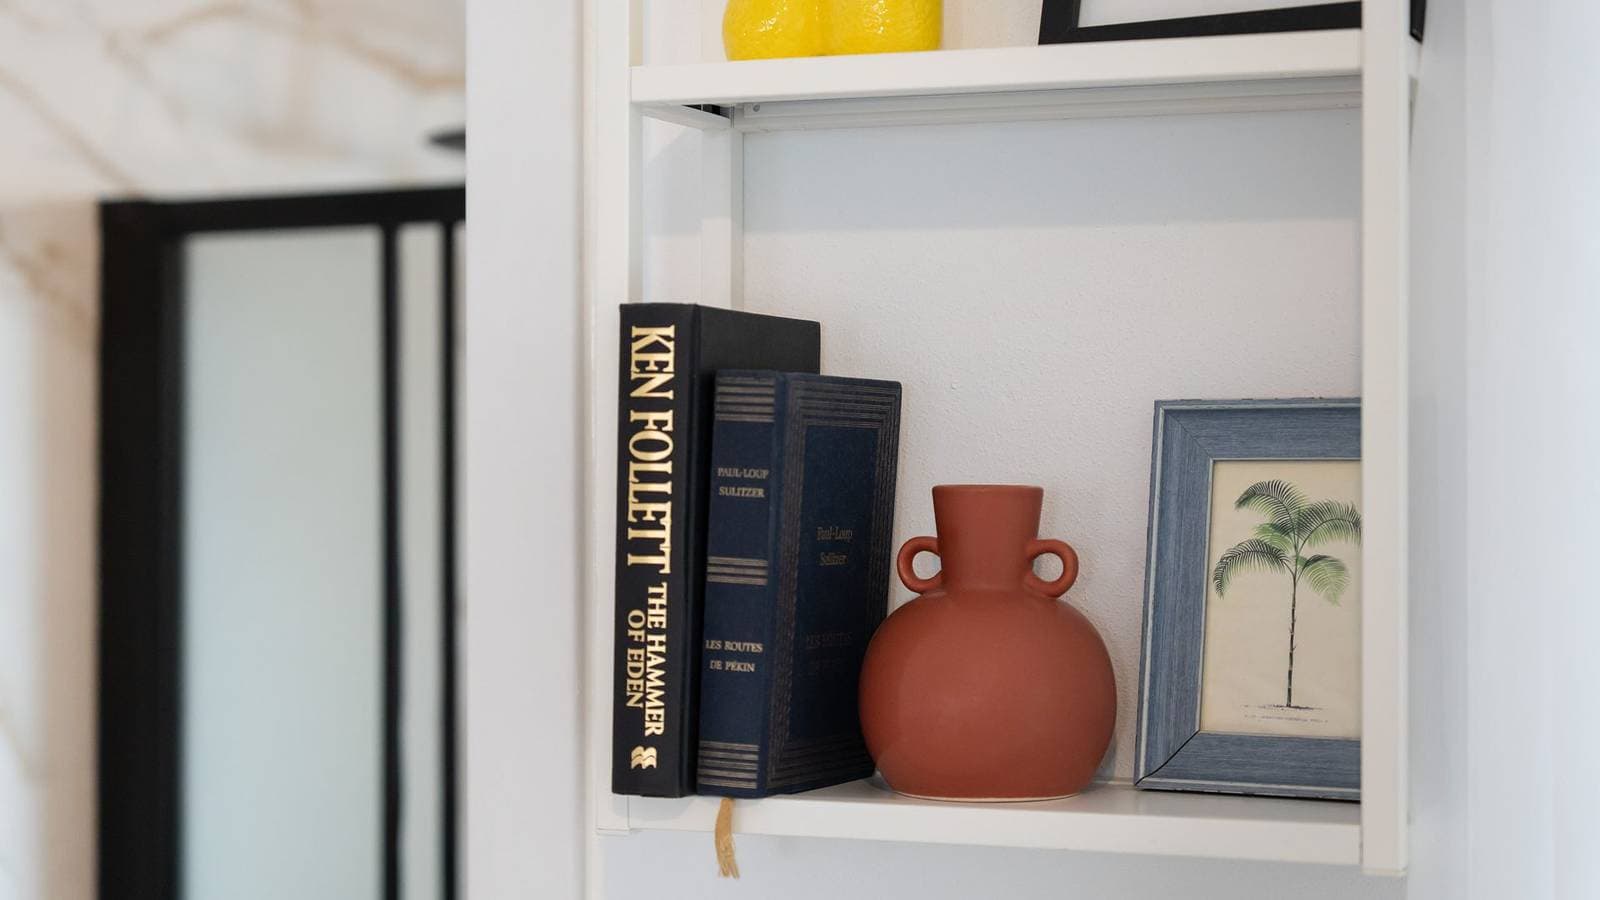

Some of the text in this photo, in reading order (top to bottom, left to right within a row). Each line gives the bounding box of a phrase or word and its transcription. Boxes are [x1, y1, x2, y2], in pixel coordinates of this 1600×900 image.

[627, 325, 675, 574] KEN FOLLETT
[717, 467, 769, 479] PAUL-LOUP
[719, 486, 765, 498] SULITZER
[705, 640, 764, 653] LES ROUTES
[626, 609, 645, 709] OF EDEN
[643, 582, 668, 737] THE HAMMER
[710, 660, 723, 670] DE
